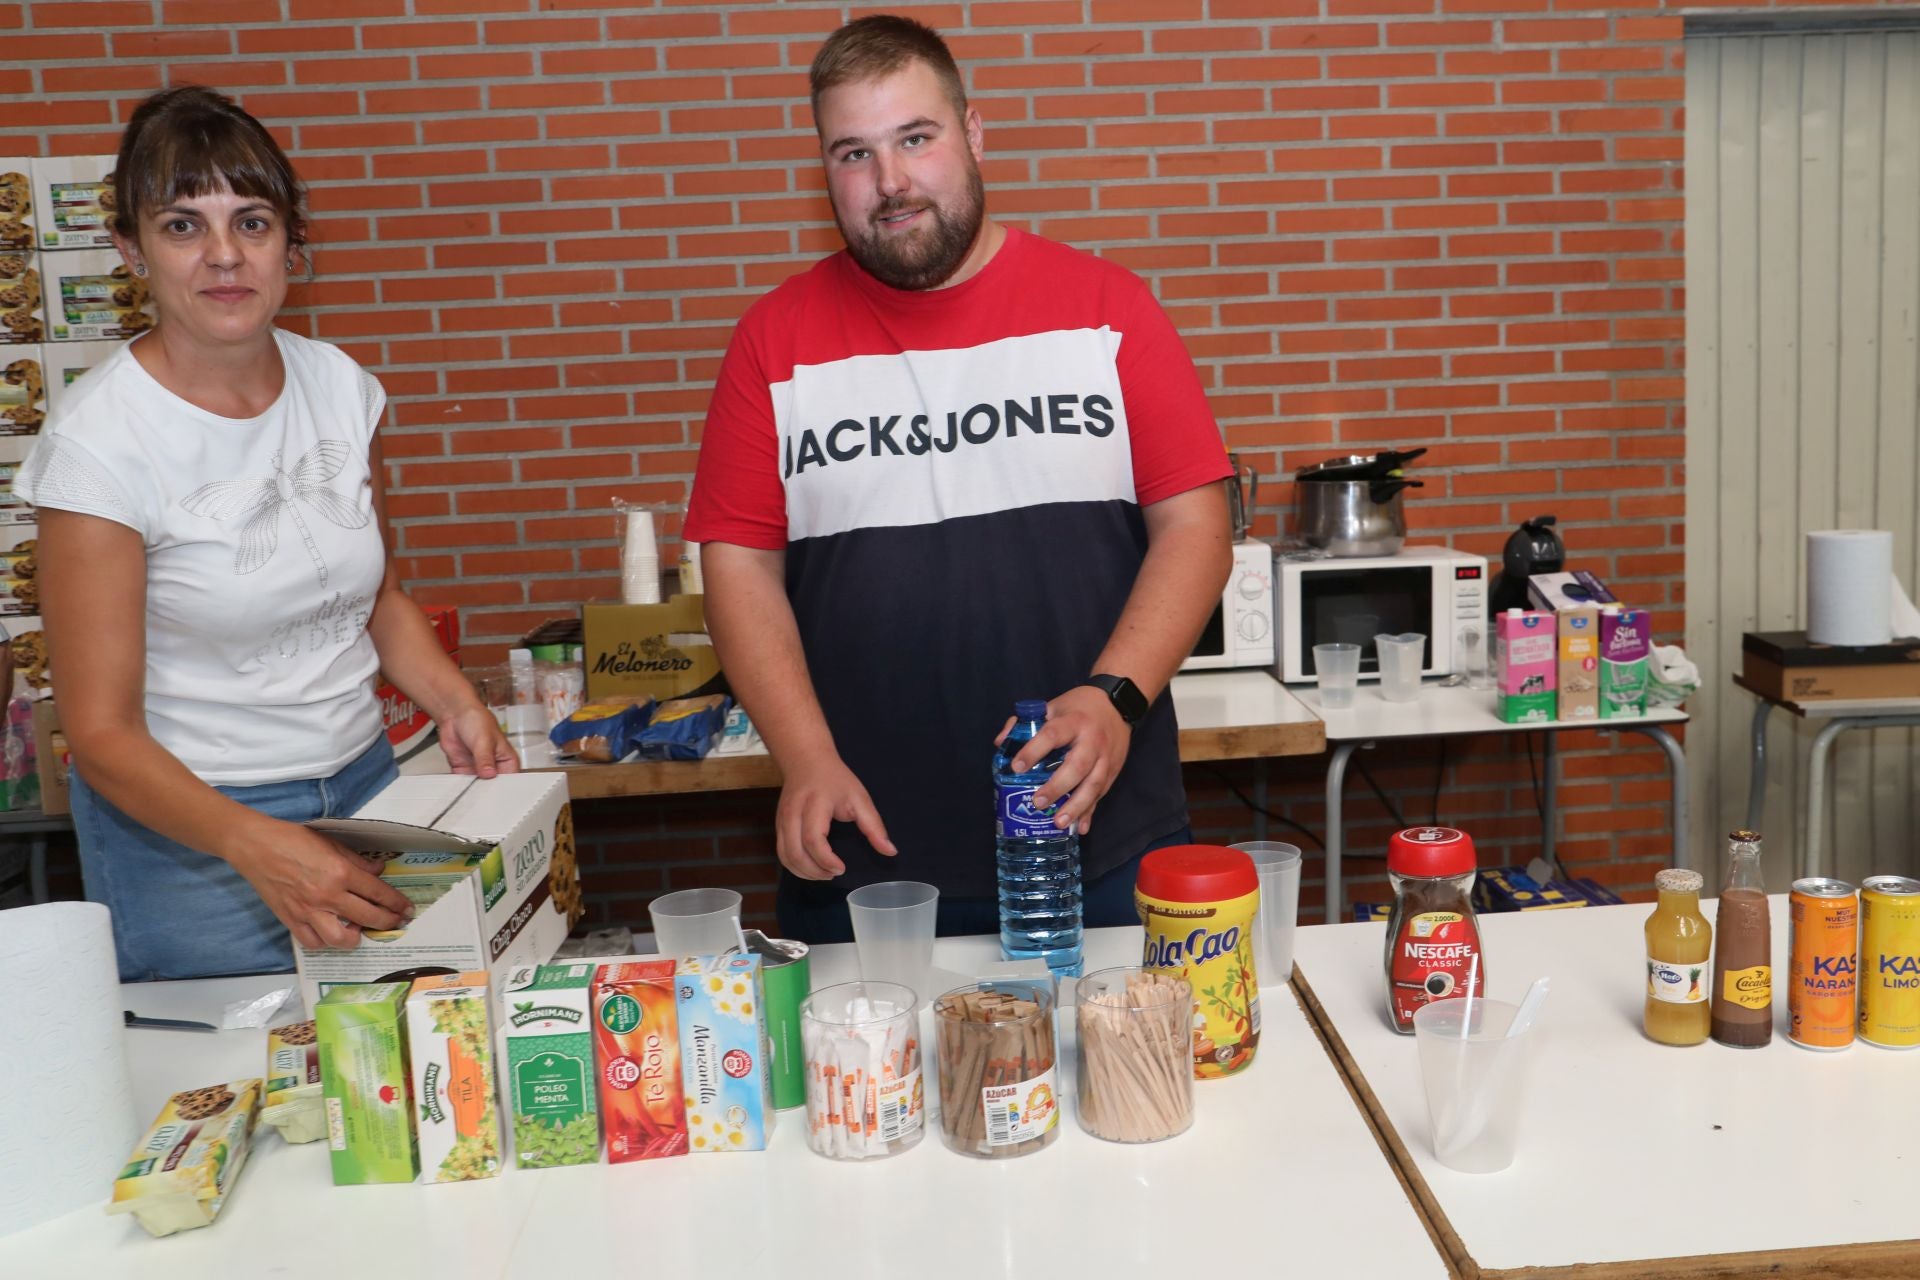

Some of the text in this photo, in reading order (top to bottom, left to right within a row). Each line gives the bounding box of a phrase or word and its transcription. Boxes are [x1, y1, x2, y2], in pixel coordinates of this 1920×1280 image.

[784, 394, 1114, 480] JACK&JONES
[1614, 627, 1637, 641] Sin
[617, 641, 631, 656] El
[591, 650, 694, 677] Melonero
[404, 855, 453, 865] zero
[511, 829, 545, 881] zero
[491, 902, 533, 955] Chip Choco
[1418, 959, 1462, 968] CLASSIC
[1879, 953, 1920, 975] KA
[1661, 971, 1681, 982] Hero
[1883, 975, 1920, 989] LIMÓ
[512, 1007, 581, 1027] HORNIMANS
[643, 1034, 664, 1105] Té Rojo
[693, 1024, 717, 1105] Manzanilla
[425, 1063, 445, 1124] HORNIMANS
[461, 1076, 474, 1105] TILA
[533, 1083, 568, 1094] POLEO
[534, 1093, 569, 1105] MENTA
